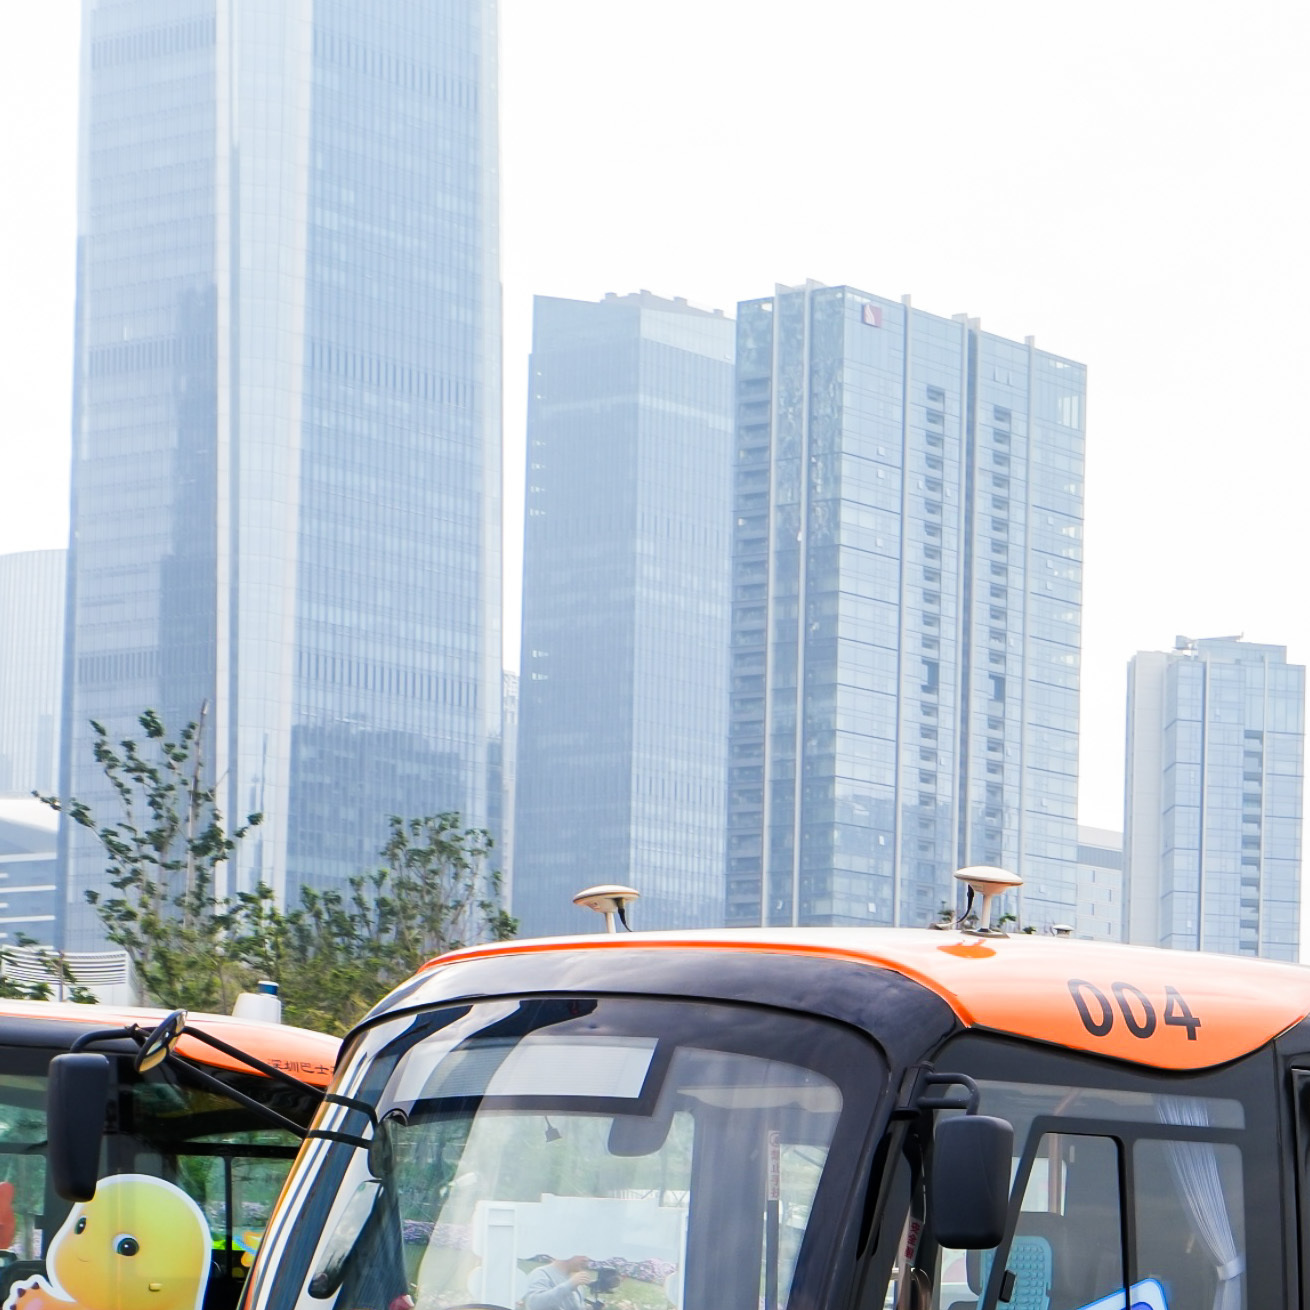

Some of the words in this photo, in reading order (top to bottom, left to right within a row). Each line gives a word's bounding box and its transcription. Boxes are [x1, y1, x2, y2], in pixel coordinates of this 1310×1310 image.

[1067, 979, 1201, 1041] 004
[268, 1059, 335, 1075] 深圳巴士
